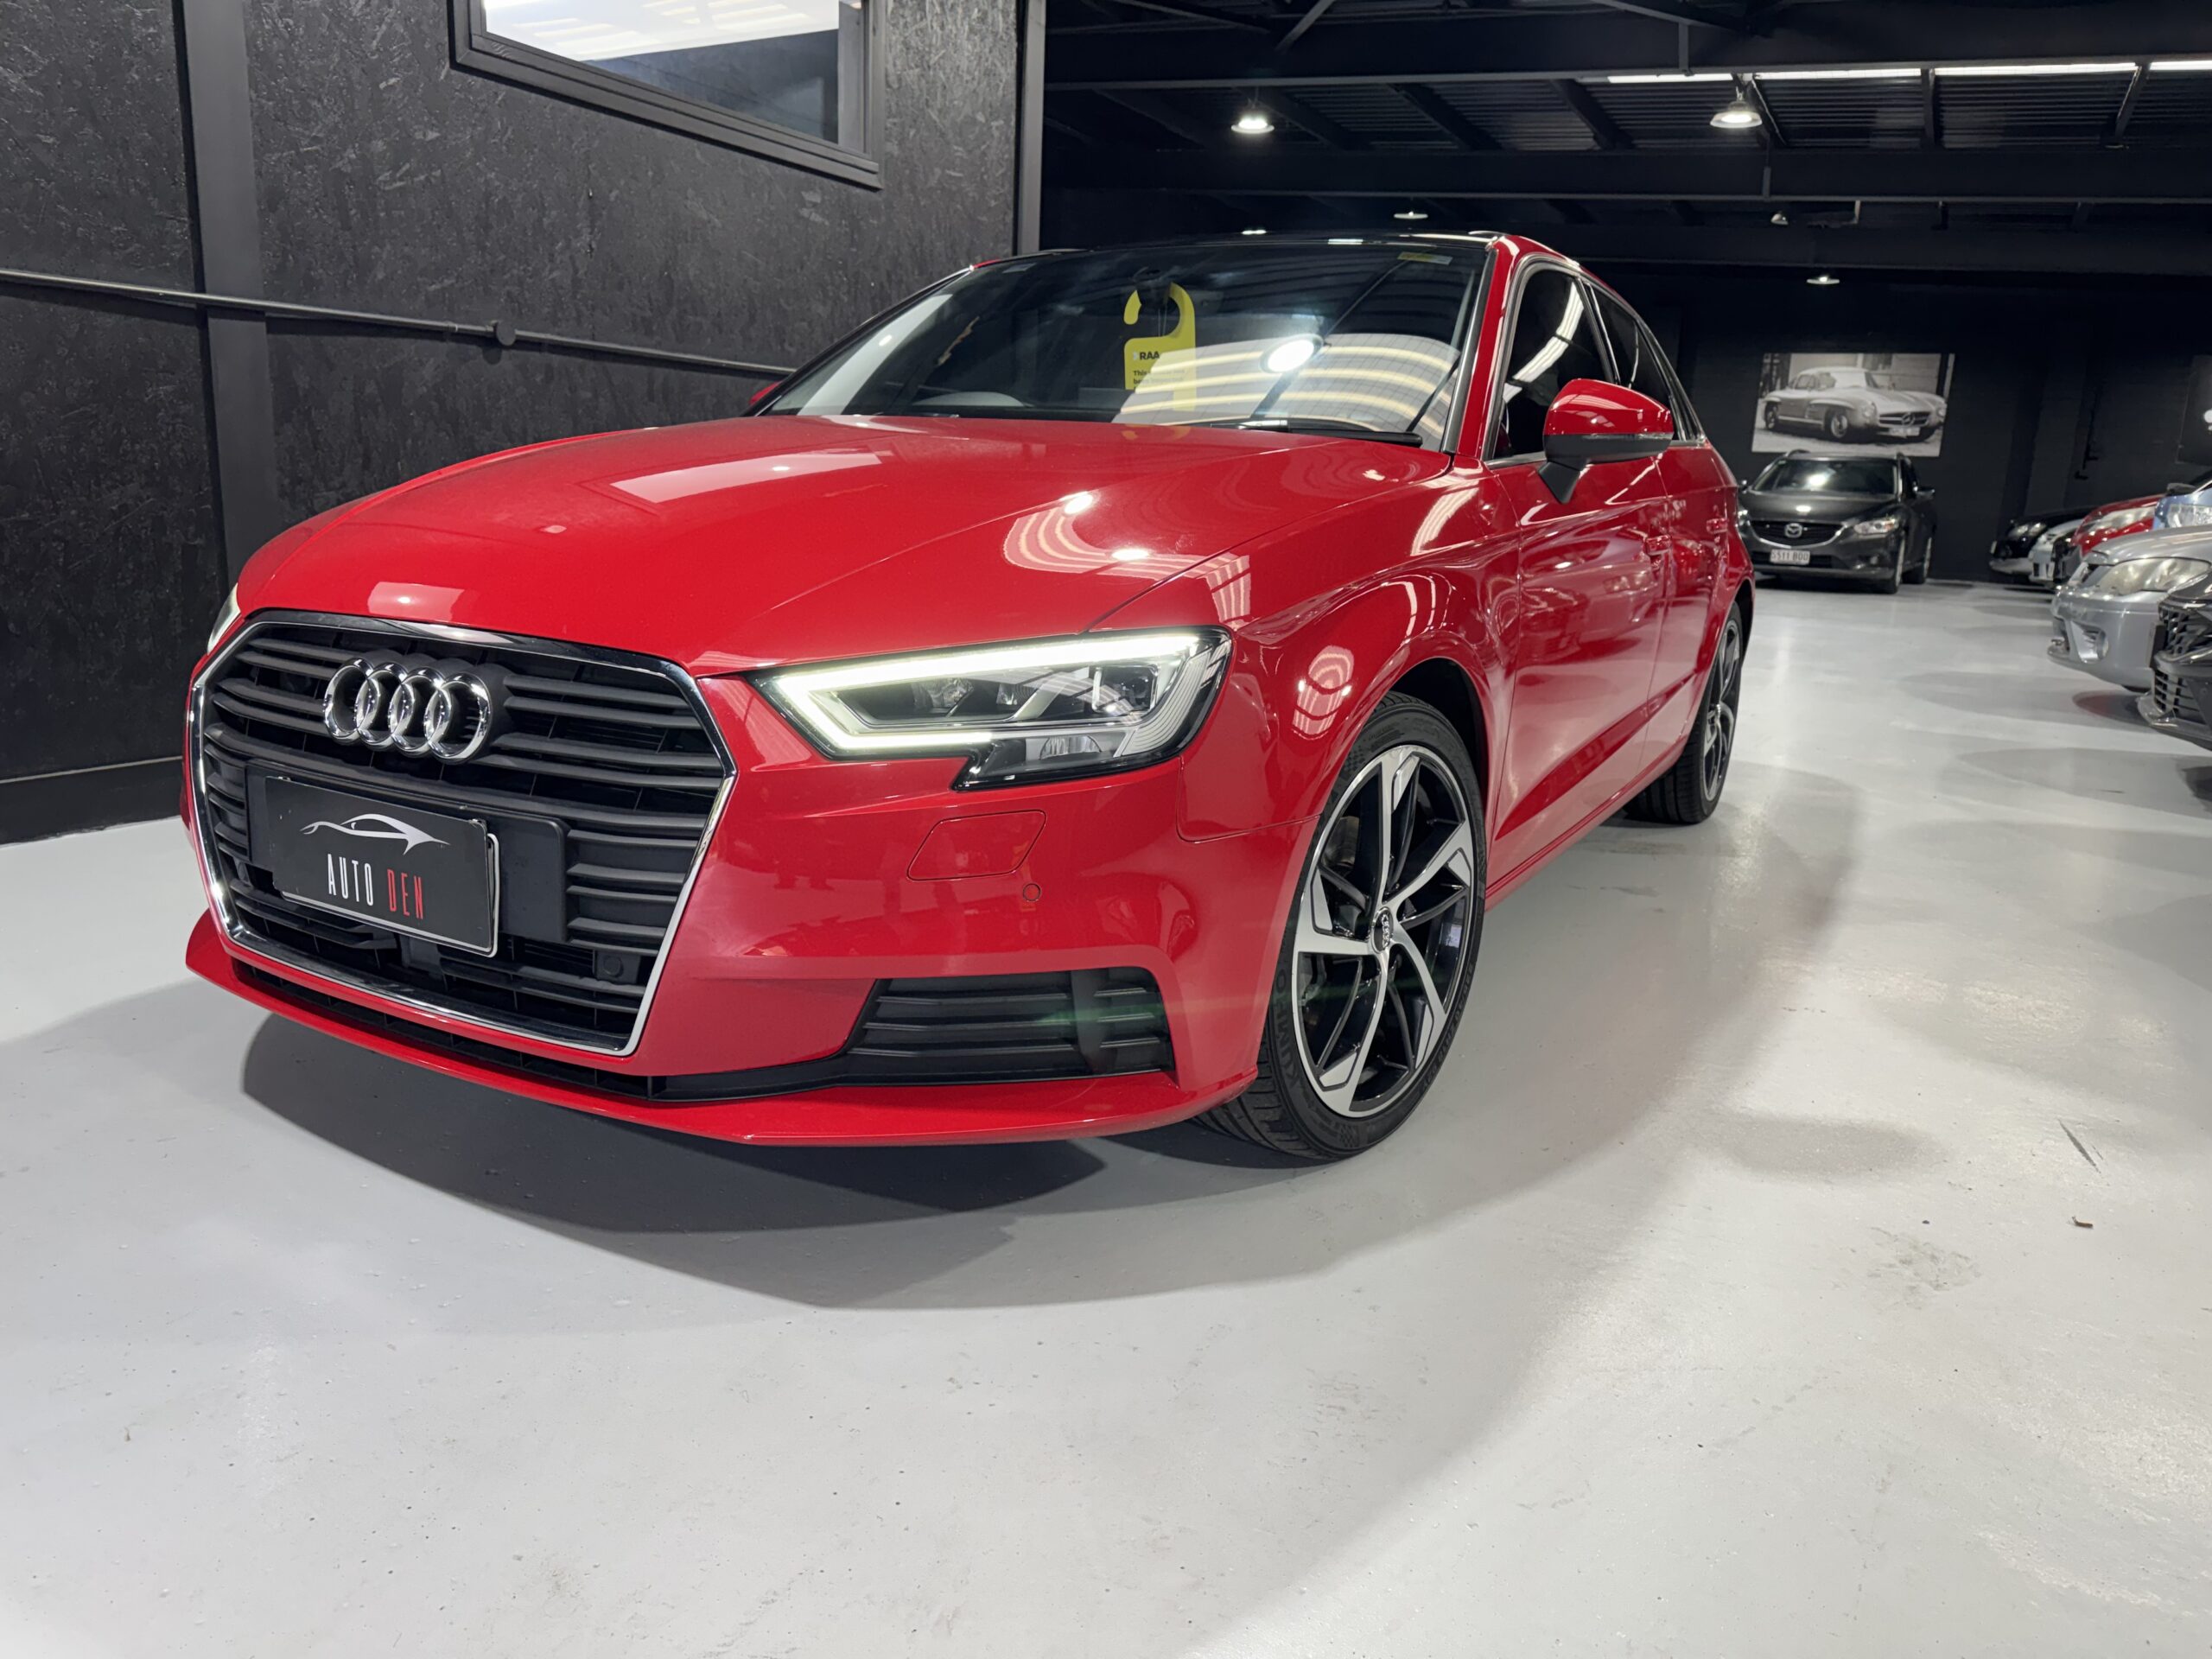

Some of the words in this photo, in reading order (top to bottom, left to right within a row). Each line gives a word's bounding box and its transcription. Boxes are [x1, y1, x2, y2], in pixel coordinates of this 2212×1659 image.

[1139, 351, 1160, 360] RAA
[327, 854, 373, 906] AUTO
[387, 868, 423, 920] DEN
[1274, 967, 1299, 1089] KUMHO
